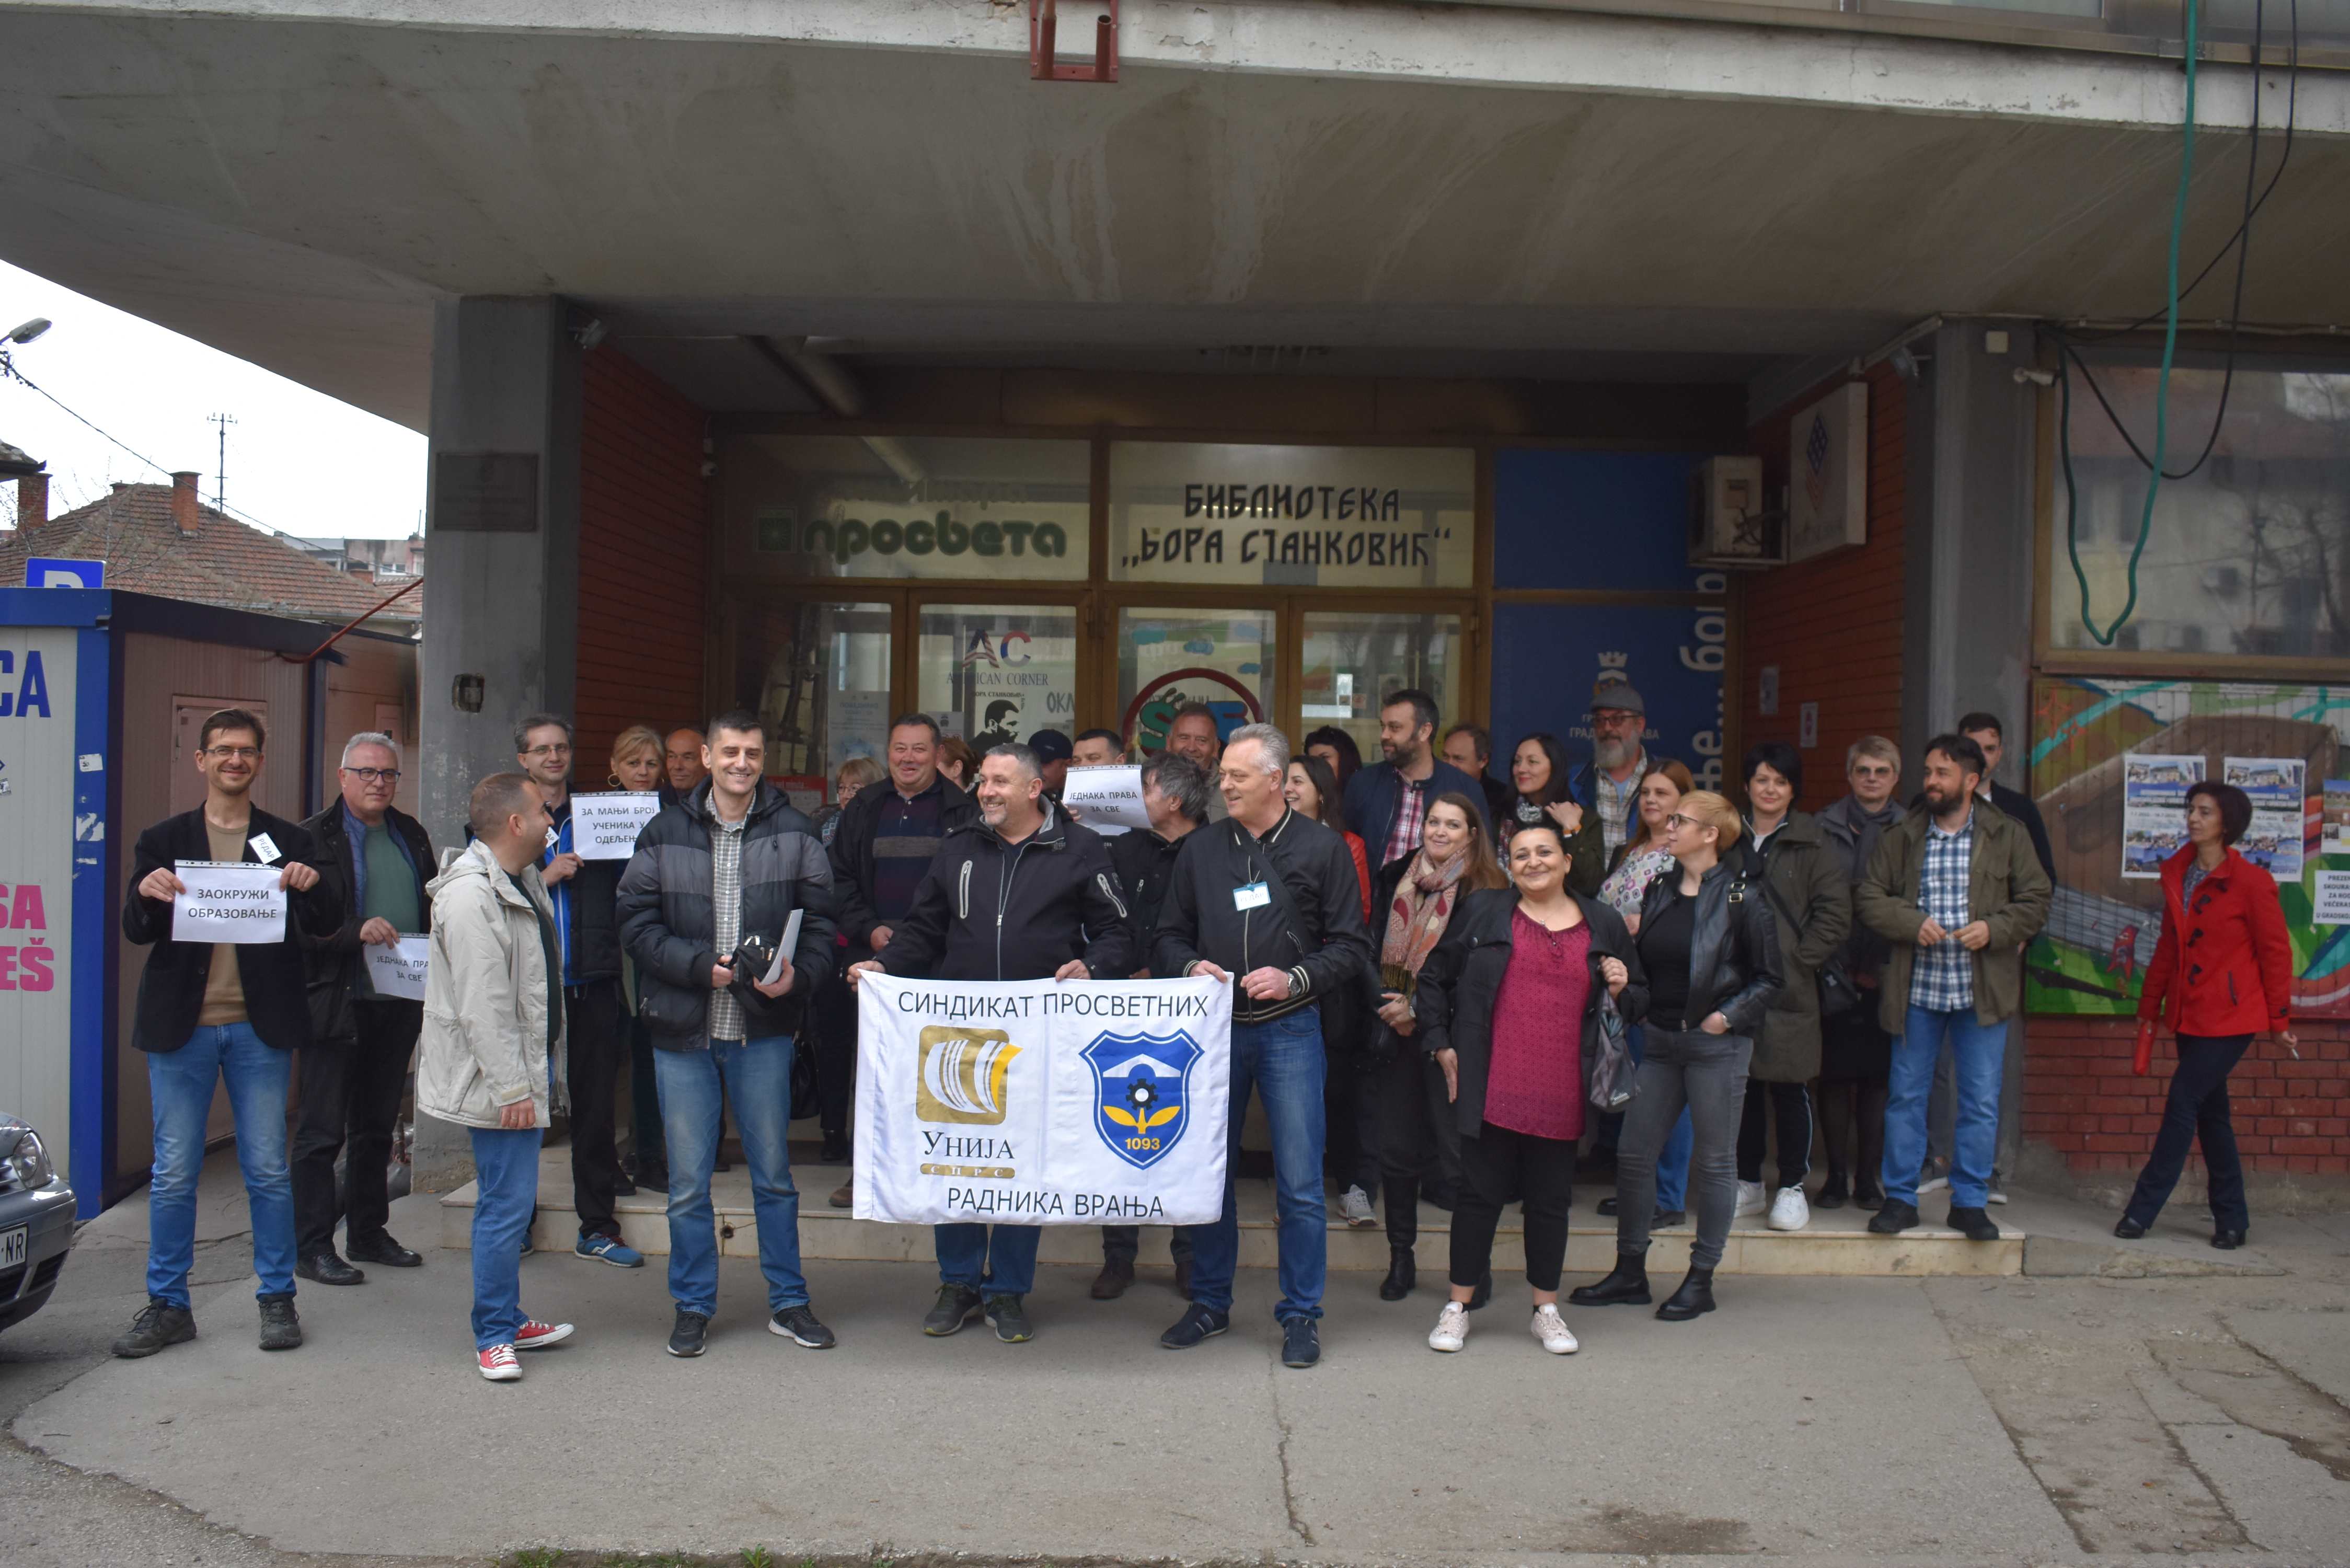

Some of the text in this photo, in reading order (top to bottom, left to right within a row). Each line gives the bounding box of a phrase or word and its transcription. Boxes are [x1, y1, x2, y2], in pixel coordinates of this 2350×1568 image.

[1185, 484, 1399, 522] БИБЛИОТЕКА
[1007, 673, 1049, 686] CORNER
[1069, 792, 1105, 801] ЈЕДНАКА
[593, 822, 635, 830] УЧЕНИКА
[595, 836, 637, 845] ОДЕЉЕЊ
[258, 838, 275, 859] РЕДАР
[198, 889, 269, 900] ЗАОКРУЖИ
[0, 883, 47, 930] A
[188, 908, 277, 919] ОБРАЗОВАЊЕ
[376, 956, 409, 967] ЈЕДНАКА
[898, 991, 1208, 1020] СИНДИКАТ ПРОСВЕТНИХ
[1125, 1138, 1160, 1150] 1093
[948, 1187, 1164, 1217] РАДНИКА ВРАЊА
